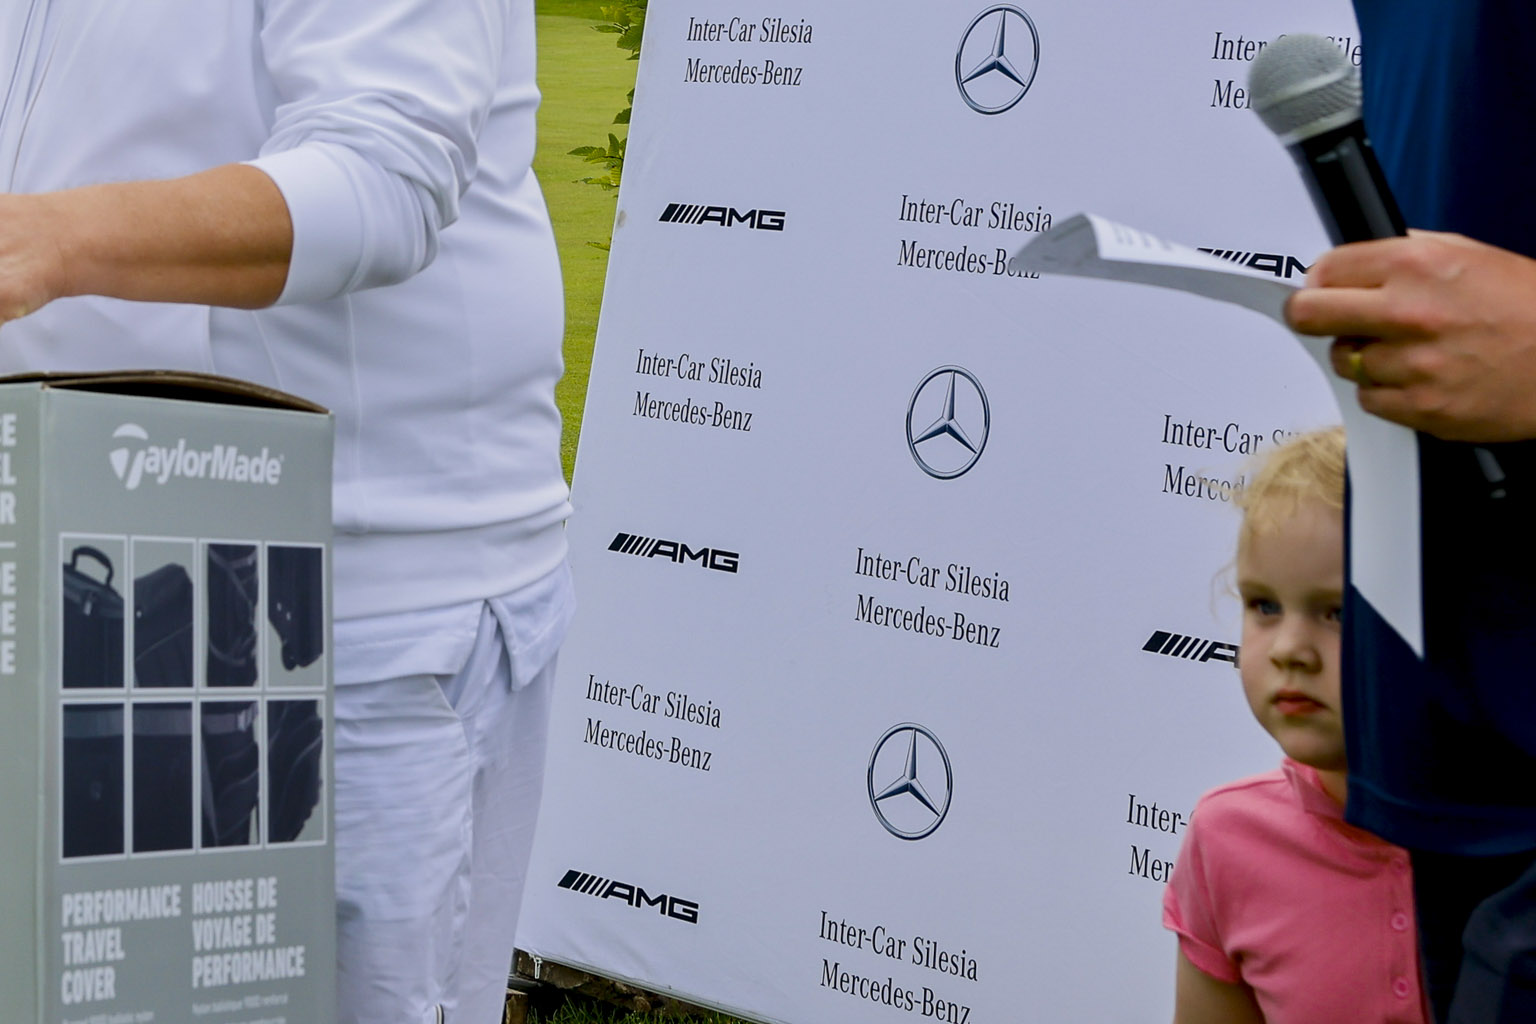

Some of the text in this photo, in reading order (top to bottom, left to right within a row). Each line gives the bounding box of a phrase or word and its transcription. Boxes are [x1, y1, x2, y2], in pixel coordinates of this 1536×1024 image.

[687, 17, 812, 43] Inter-Car Silesia
[684, 58, 802, 86] Mercedes-Benz
[696, 206, 786, 231] AMG
[899, 195, 1052, 233] Inter-Car Silesia
[897, 239, 1040, 279] Mercedes-Be
[636, 349, 761, 389] Inter-Car Silesia
[633, 391, 752, 431] Mercedes-Benz
[1162, 415, 1263, 455] Inter-Car
[110, 424, 280, 490] TaylorMade
[647, 540, 739, 573] AMG
[855, 548, 1009, 602] Inter-Car Silesia
[855, 594, 1000, 648] Mercedes-Benz
[586, 674, 720, 728] Inter-Car Silesia
[584, 718, 711, 771] Mercedes-Benz
[1127, 794, 1188, 834] Inter-
[62, 885, 181, 926] PERFORMANCE
[192, 877, 277, 914] HOUSSE DE
[601, 881, 699, 924] AMG
[62, 928, 124, 965] TRAVEL
[192, 913, 275, 951] VOYAGE DE
[819, 911, 977, 981] Inter-Car Silesia
[62, 966, 115, 1004] COVER
[192, 946, 305, 988] PERFORMANCE
[820, 959, 970, 1024] Mercedes-Benz
